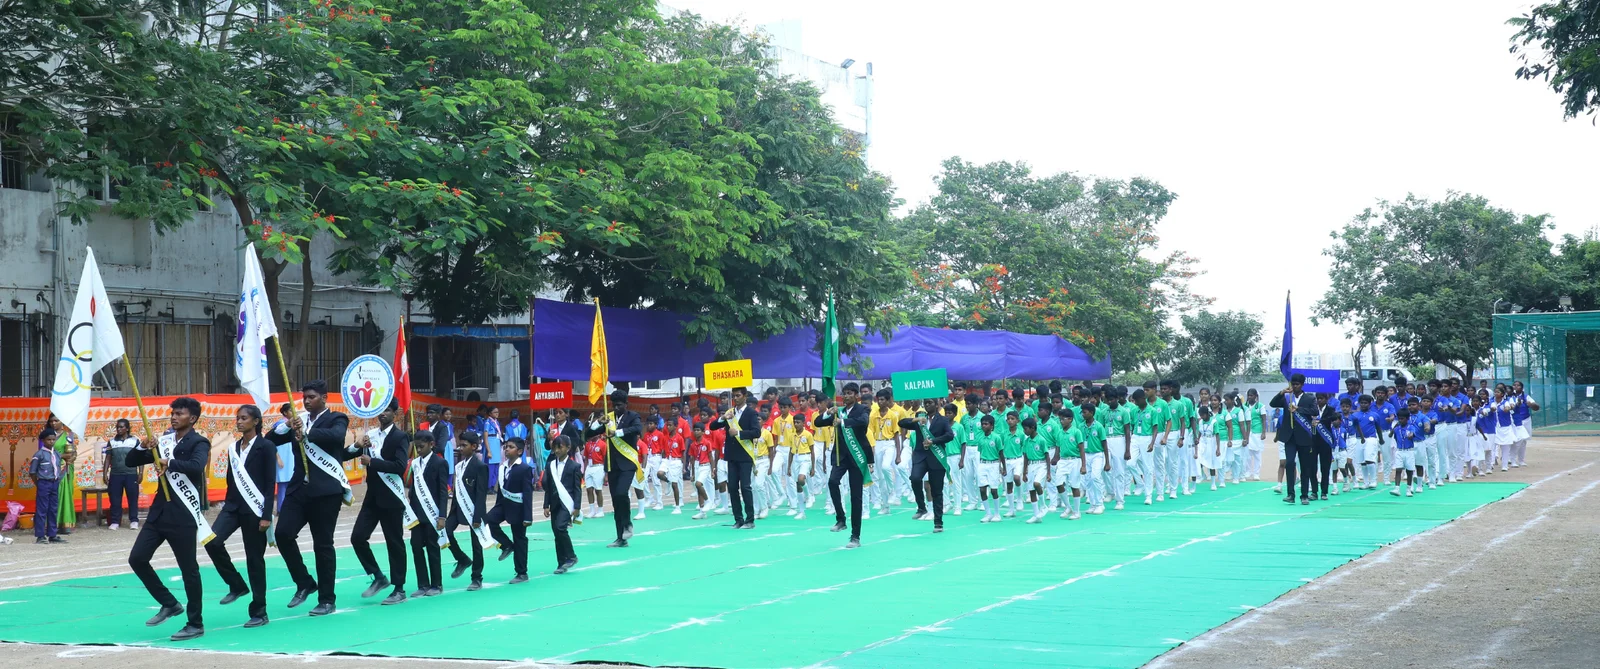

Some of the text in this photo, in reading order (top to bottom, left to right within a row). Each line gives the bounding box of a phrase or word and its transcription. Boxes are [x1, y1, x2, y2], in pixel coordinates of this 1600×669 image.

[712, 369, 744, 380] BHASKARA
[904, 379, 935, 391] KALPANA
[534, 391, 565, 400] ARYABHATA
[849, 440, 865, 464] CAPTAIN
[317, 456, 338, 473] PUPIL
[236, 470, 256, 500] ASSISTANT
[385, 475, 402, 493] SCHOOL
[415, 476, 437, 517] PRIMARY SPORTS
